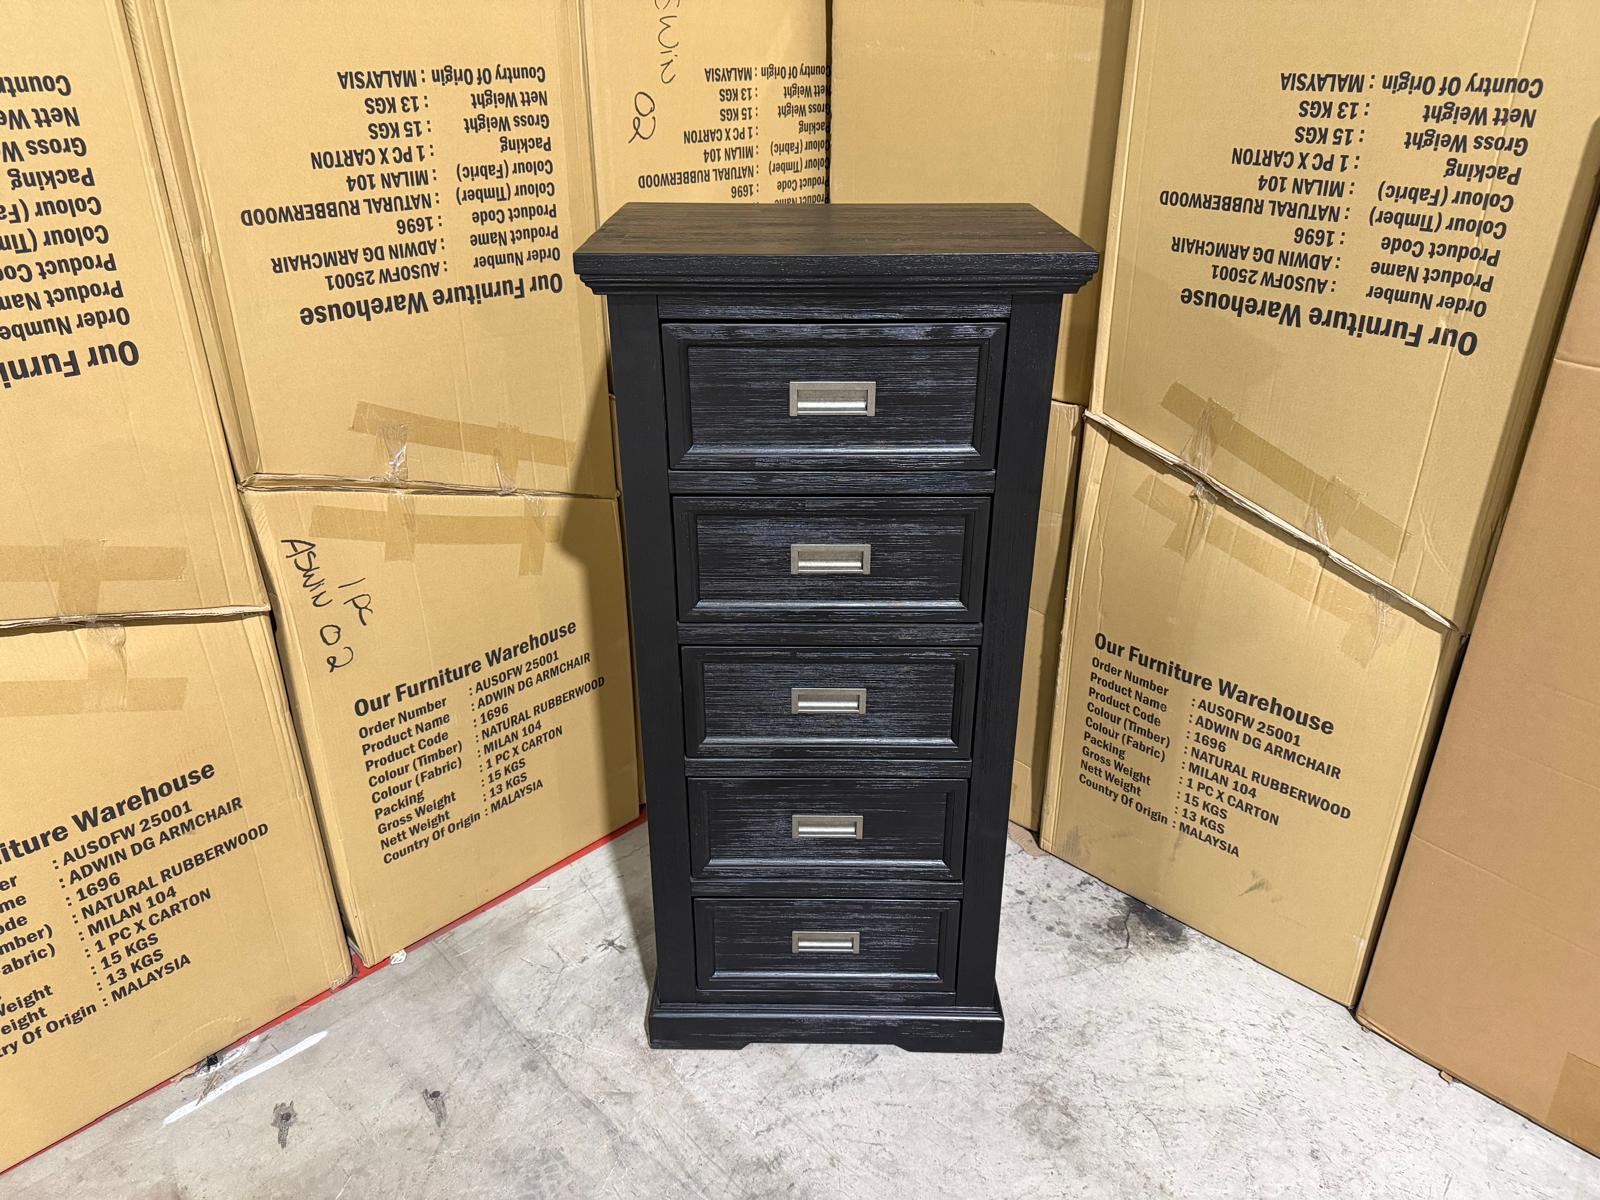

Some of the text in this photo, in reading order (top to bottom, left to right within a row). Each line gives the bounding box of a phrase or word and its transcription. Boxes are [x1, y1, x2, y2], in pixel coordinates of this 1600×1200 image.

[431, 63, 546, 87] Country Of Origin
[760, 63, 787, 80] Origin
[787, 65, 798, 80] Of
[1381, 71, 1544, 99] Country Of Origin
[470, 89, 548, 110] Nett Weight
[783, 82, 813, 99] Weight
[30, 106, 81, 128] Nett
[463, 113, 550, 134] Gross Weight
[777, 101, 807, 119] Weight
[1421, 101, 1537, 128] Nett Weight
[25, 136, 87, 157] Gross
[499, 135, 552, 154] Packing
[770, 138, 804, 157] (Fabric)
[1403, 128, 1529, 157] Gross Weight
[6, 167, 96, 191] Packing
[456, 159, 554, 183] Colour (Fabric)
[637, 168, 711, 189] RUBBERWOOD
[768, 156, 803, 176] (Timber)
[1442, 157, 1522, 186] Packing
[455, 181, 556, 206] Colour (Timber)
[776, 178, 798, 193] Code
[1377, 180, 1514, 213] Colour (Fabric)
[34, 196, 102, 218] Colour
[471, 203, 557, 226] Product Code
[1159, 190, 1265, 215] RUBBERWOOD
[1368, 205, 1443, 233] (Timber)
[1444, 217, 1507, 240] Colour
[42, 224, 109, 247] Colour
[469, 230, 508, 247] Name
[509, 224, 559, 245] Product
[270, 248, 359, 274] ARMCHAIR
[362, 245, 386, 263] DG
[473, 251, 524, 270] Number
[526, 246, 561, 264] Order
[1380, 236, 1501, 267] Product Code
[34, 252, 117, 280] Product
[1211, 264, 1259, 285] 25001
[1370, 261, 1495, 293] Product Name
[324, 269, 376, 291] 25001
[43, 280, 125, 308] Product
[299, 272, 563, 326] Our Furniture Warehouse
[1365, 285, 1434, 311] Number
[1435, 295, 1487, 318] Order
[76, 306, 131, 330] Order
[1180, 287, 1478, 357] Our Furniture Warehouse
[87, 340, 140, 368] Our
[354, 621, 577, 717] Our Furniture Warehouse
[1091, 656, 1170, 697] Order Number
[1094, 632, 1334, 735] Our Furniture Warehouse
[361, 726, 414, 756] Product
[414, 713, 451, 736] Name
[517, 676, 534, 692] DG
[535, 652, 591, 685] ARMCHAIR
[1088, 686, 1161, 727] Product Code
[358, 697, 447, 739] Order Number
[1089, 671, 1133, 699] Product
[1134, 689, 1168, 713] Name
[1242, 732, 1262, 750] DG
[1263, 741, 1342, 780] ARMCHAIR
[368, 763, 410, 788] Colour
[412, 740, 463, 772] (Timber)
[532, 676, 605, 717] RUBBERWOOD
[1083, 730, 1127, 761] Packing
[1085, 716, 1166, 763] Colour (Fabric)
[364, 731, 449, 773] Product Code
[1081, 745, 1152, 786] Gross Weight
[1086, 701, 1122, 726] Colour
[1123, 717, 1171, 749] (Timber)
[1250, 770, 1351, 819] RUBBERWOOD
[371, 756, 462, 804] Colour (Fabric)
[1080, 758, 1142, 797] Nett Weight
[70, 763, 215, 833] Warehouse
[374, 789, 425, 820] Packing
[1078, 773, 1168, 825] Country Of Origin
[129, 836, 156, 857] DG
[159, 796, 244, 845] ARMCHAIR
[138, 800, 193, 833] 25001
[377, 791, 457, 835] Gross Weight
[380, 809, 451, 851] Nett Weight
[383, 812, 481, 865] Country Of Origin
[159, 823, 269, 884] RUBBERWOOD
[145, 885, 177, 910] 104
[124, 932, 159, 958] KGS
[130, 948, 164, 974] KGS
[21, 1025, 43, 1045] Of
[45, 1004, 97, 1034] Origin
